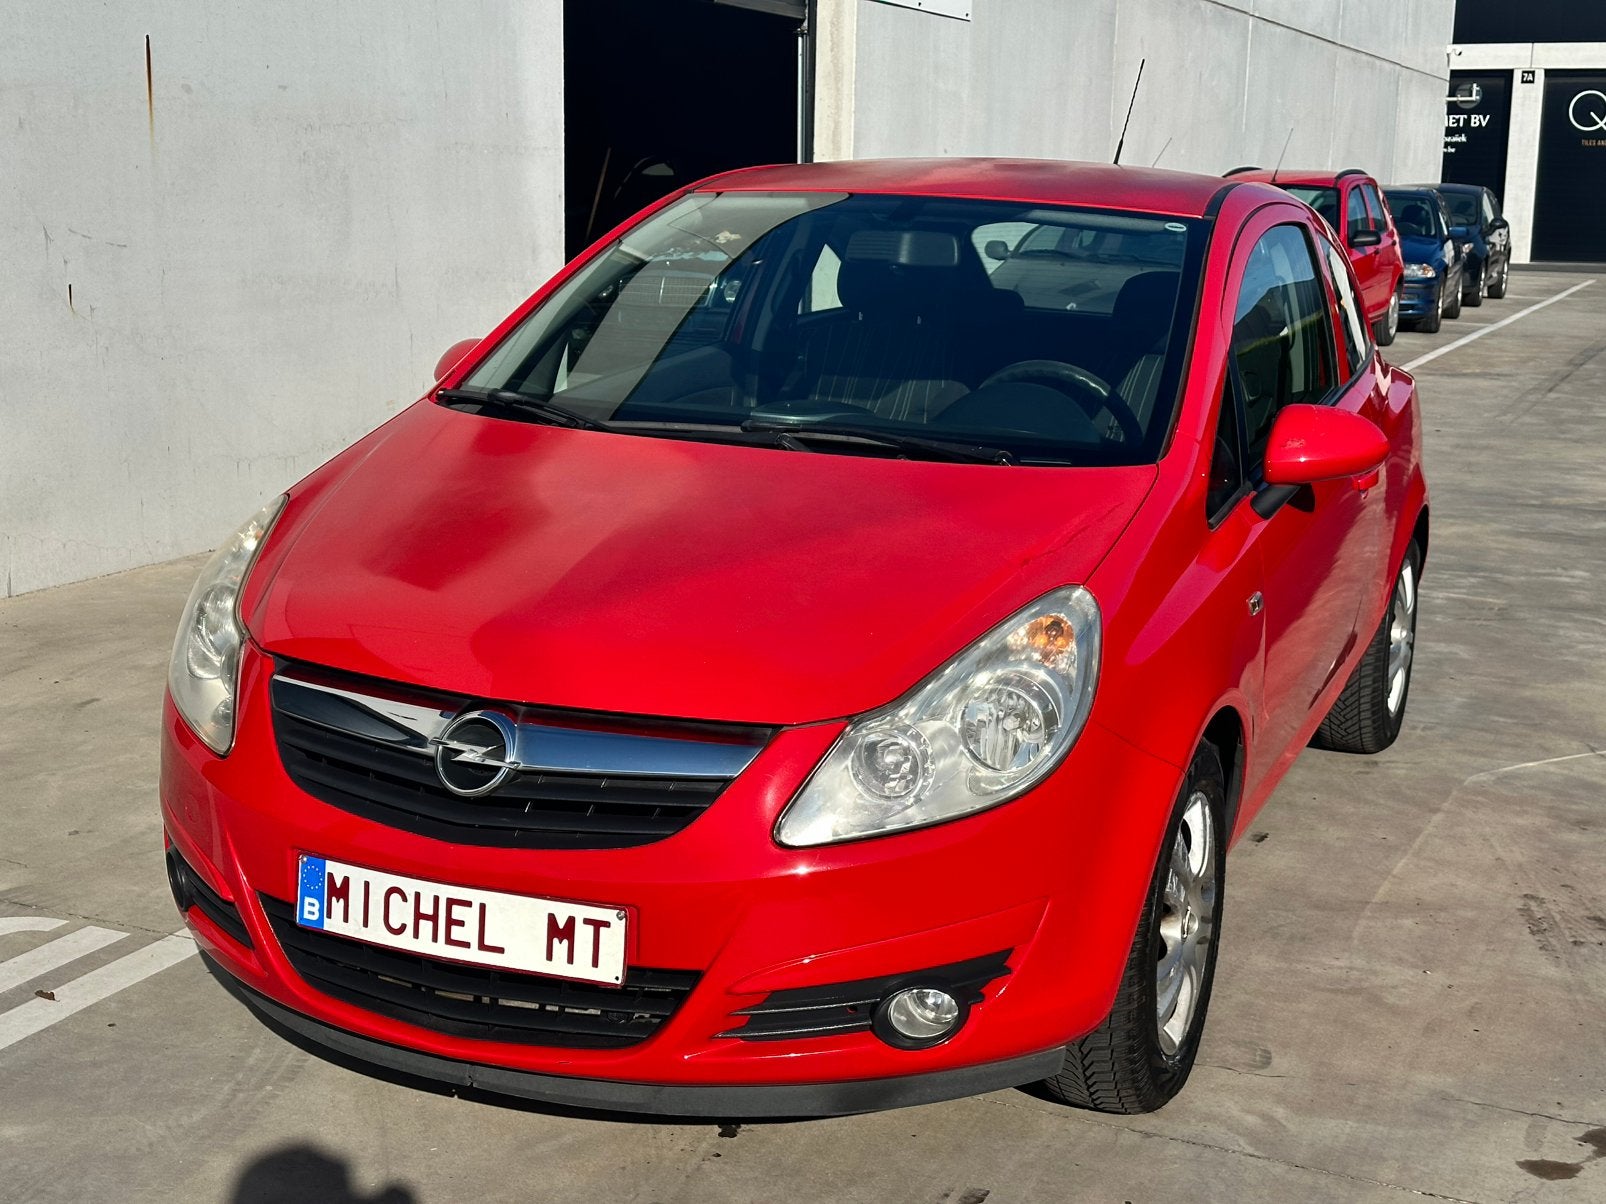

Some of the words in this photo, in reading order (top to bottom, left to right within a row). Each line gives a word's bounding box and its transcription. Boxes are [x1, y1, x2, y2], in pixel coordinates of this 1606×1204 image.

[1522, 73, 1534, 81] 7A
[1470, 115, 1490, 127] BV
[303, 896, 320, 921] B
[326, 872, 505, 954] MICHEL
[546, 912, 611, 968] MT
